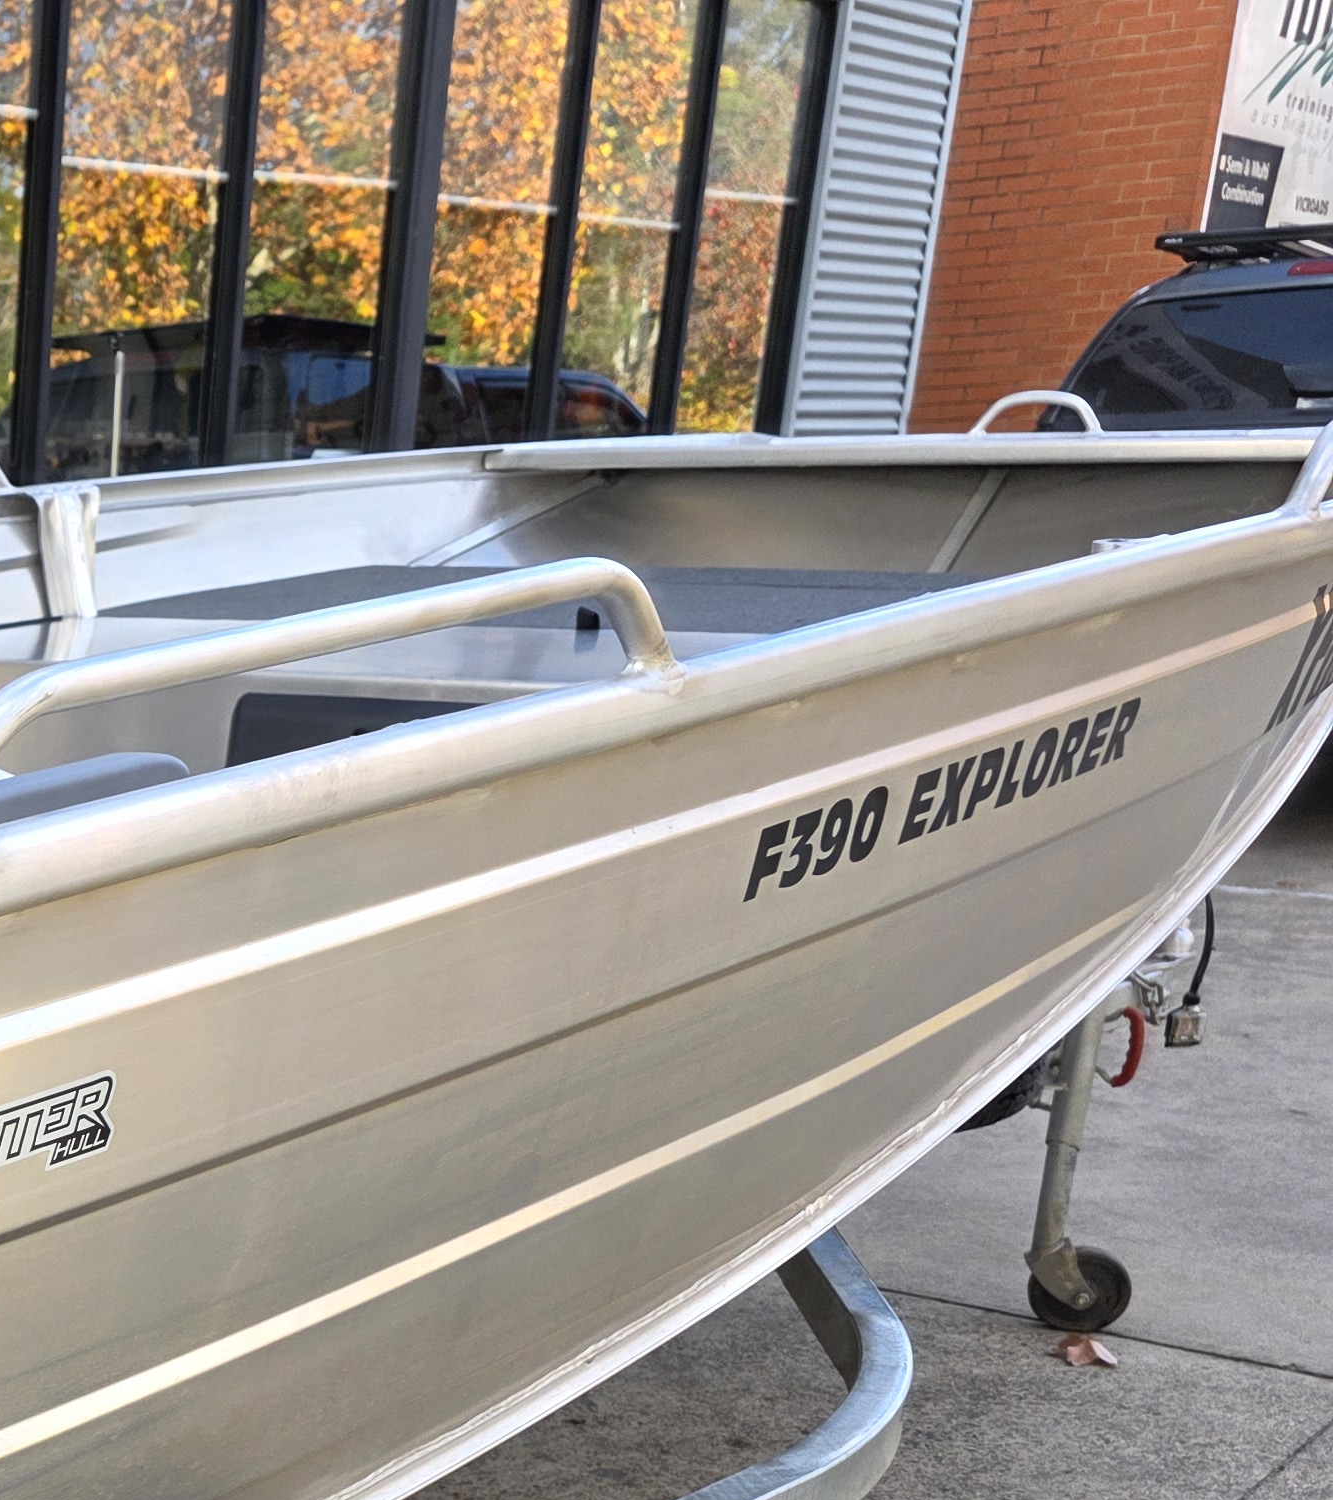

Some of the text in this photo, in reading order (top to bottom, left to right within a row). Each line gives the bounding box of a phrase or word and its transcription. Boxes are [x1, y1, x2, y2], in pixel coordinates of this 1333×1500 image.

[743, 697, 1142, 903] F390 EXPLORER
[53, 1128, 107, 1163] HULL
